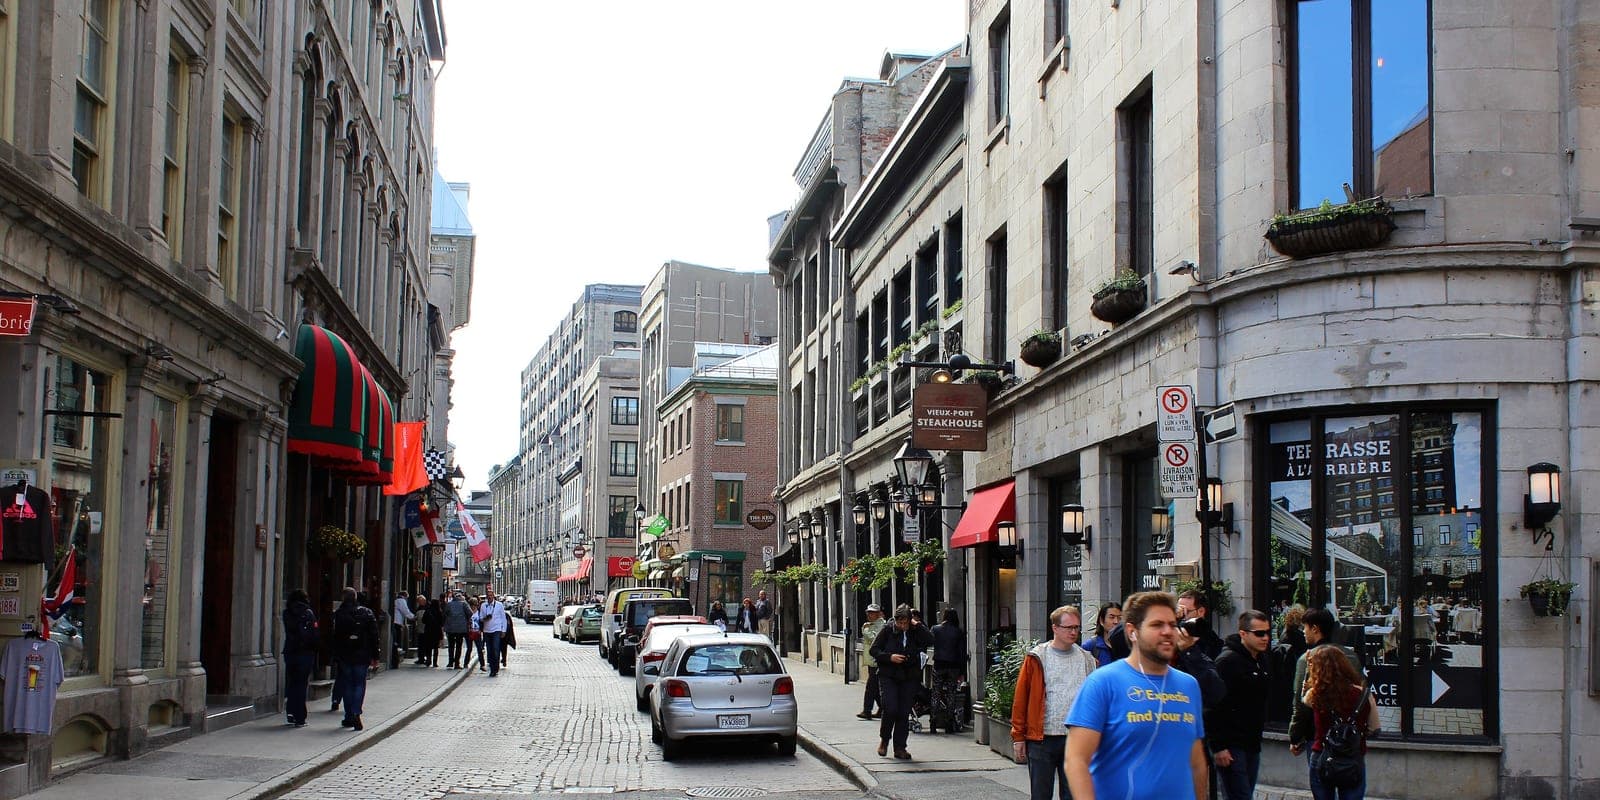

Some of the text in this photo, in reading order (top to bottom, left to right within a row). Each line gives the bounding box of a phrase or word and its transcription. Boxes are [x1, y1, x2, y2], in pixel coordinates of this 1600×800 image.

[926, 408, 974, 417] VIEUX-PORT
[917, 418, 984, 428] STEAKHOUSE
[1163, 466, 1194, 475] LIVRAISON
[1286, 463, 1295, 477] À
[1162, 474, 1195, 482] SEULEMENT
[1182, 485, 1194, 493] VEN
[1126, 710, 1153, 723] find
[1154, 711, 1181, 724] your
